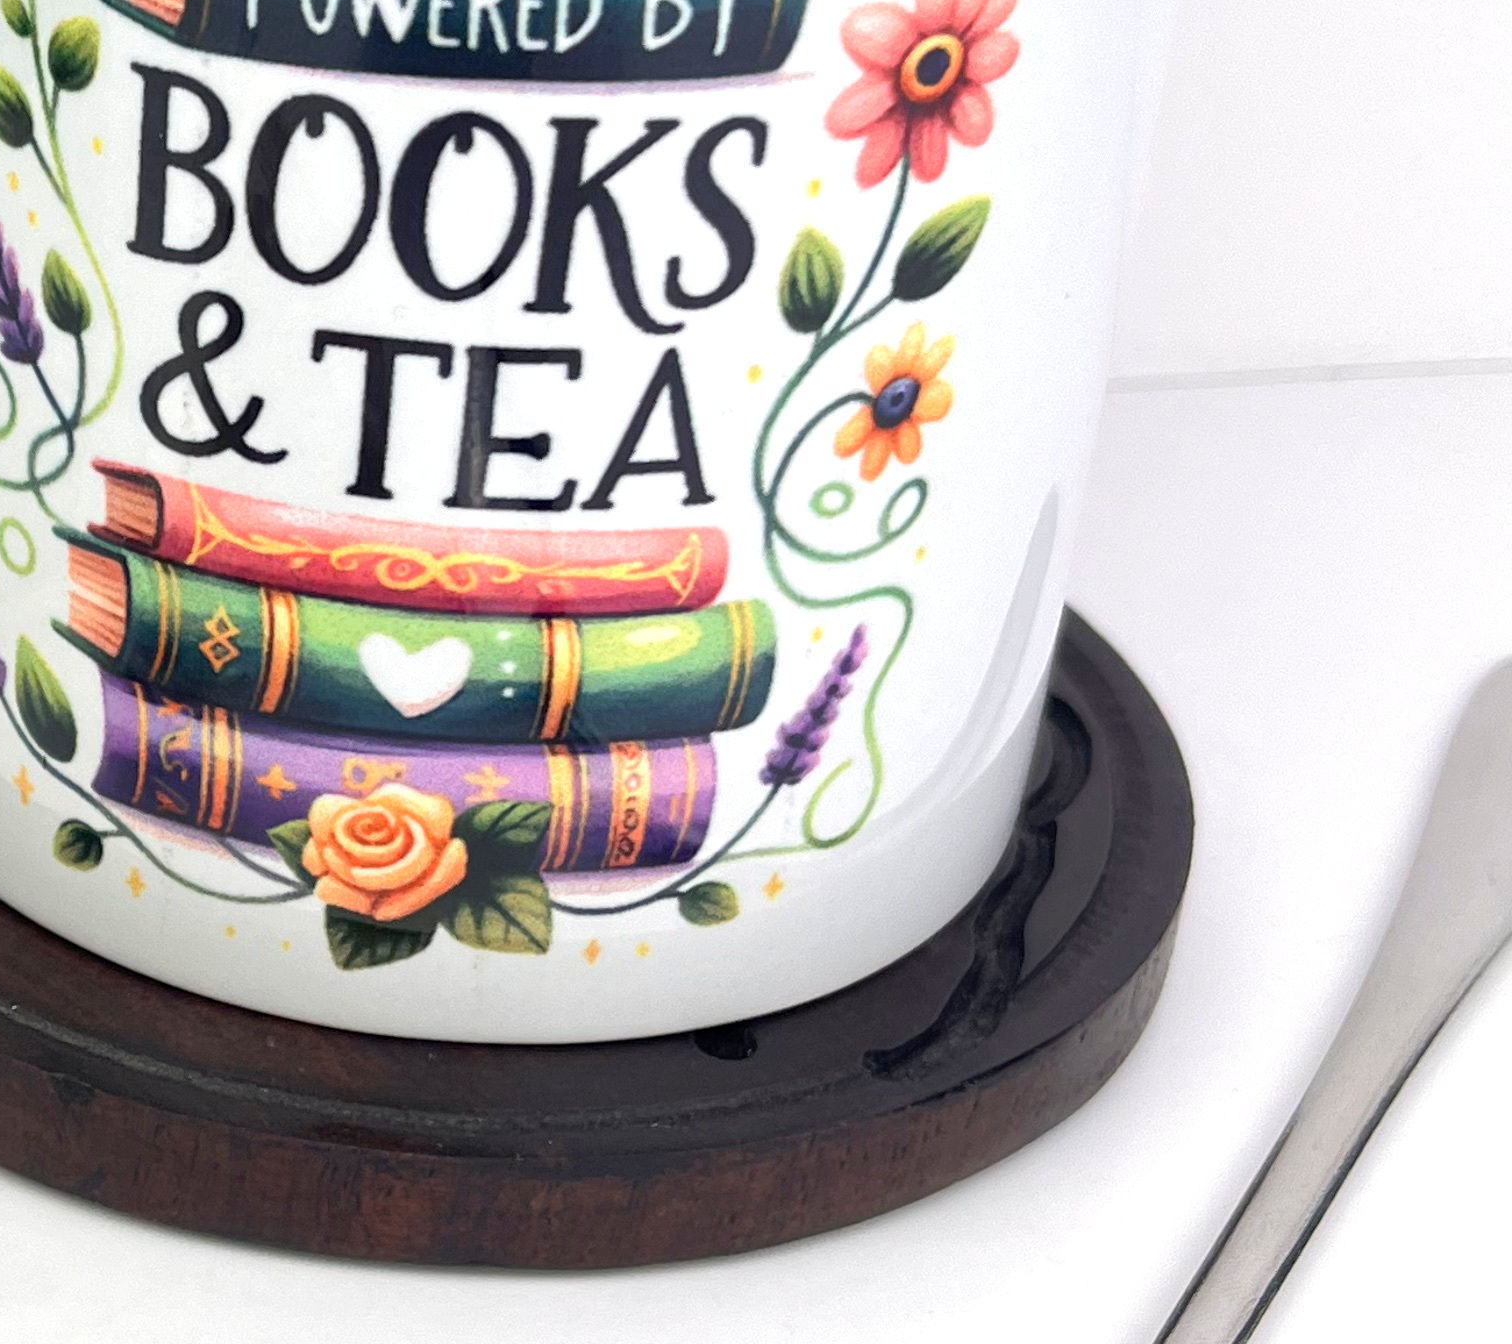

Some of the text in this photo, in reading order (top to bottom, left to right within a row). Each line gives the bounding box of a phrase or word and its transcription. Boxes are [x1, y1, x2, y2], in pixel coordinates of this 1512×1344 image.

[126, 61, 769, 334] BOOKS
[140, 290, 716, 512] & TEA
